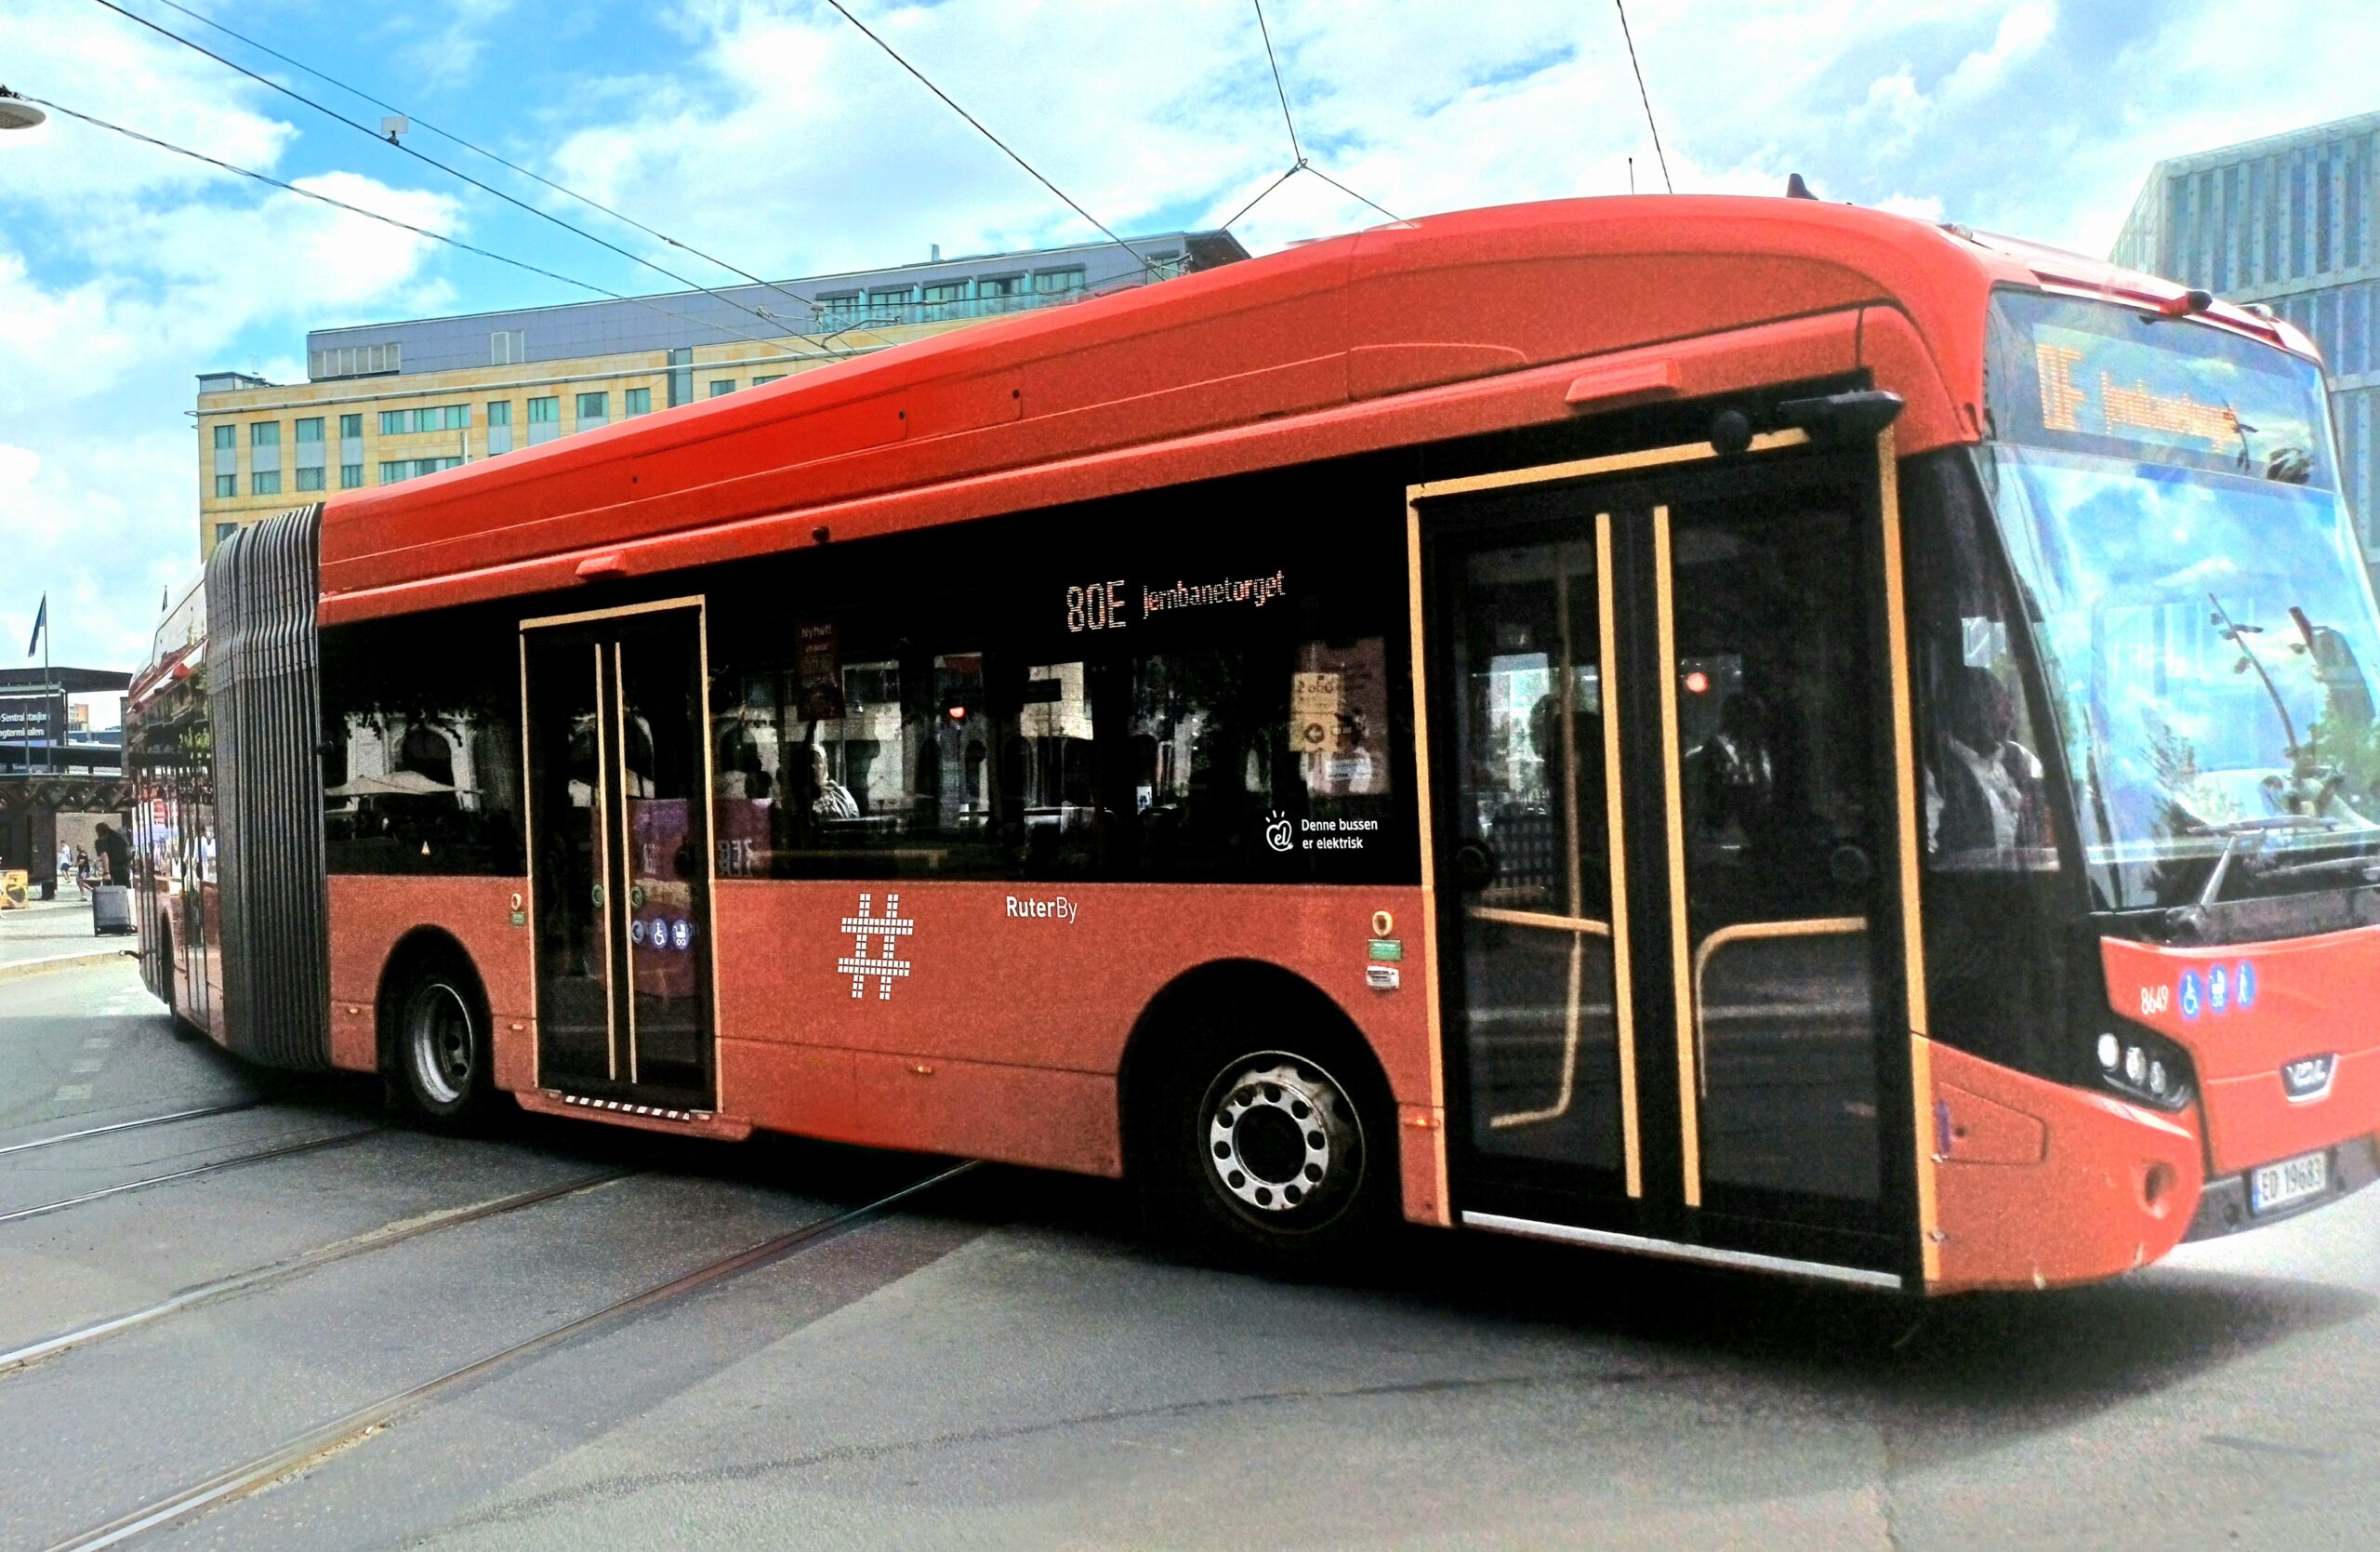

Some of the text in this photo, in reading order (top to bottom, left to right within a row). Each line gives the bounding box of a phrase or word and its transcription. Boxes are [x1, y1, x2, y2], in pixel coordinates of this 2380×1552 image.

[1067, 579, 1127, 632] 80E
[1, 711, 51, 723] Sentraltasjon
[1302, 817, 1378, 831] Denne bussen
[1302, 837, 1364, 850] er elektrisk
[1006, 895, 1078, 924] RuterBy
[2140, 984, 2169, 1015] 8649
